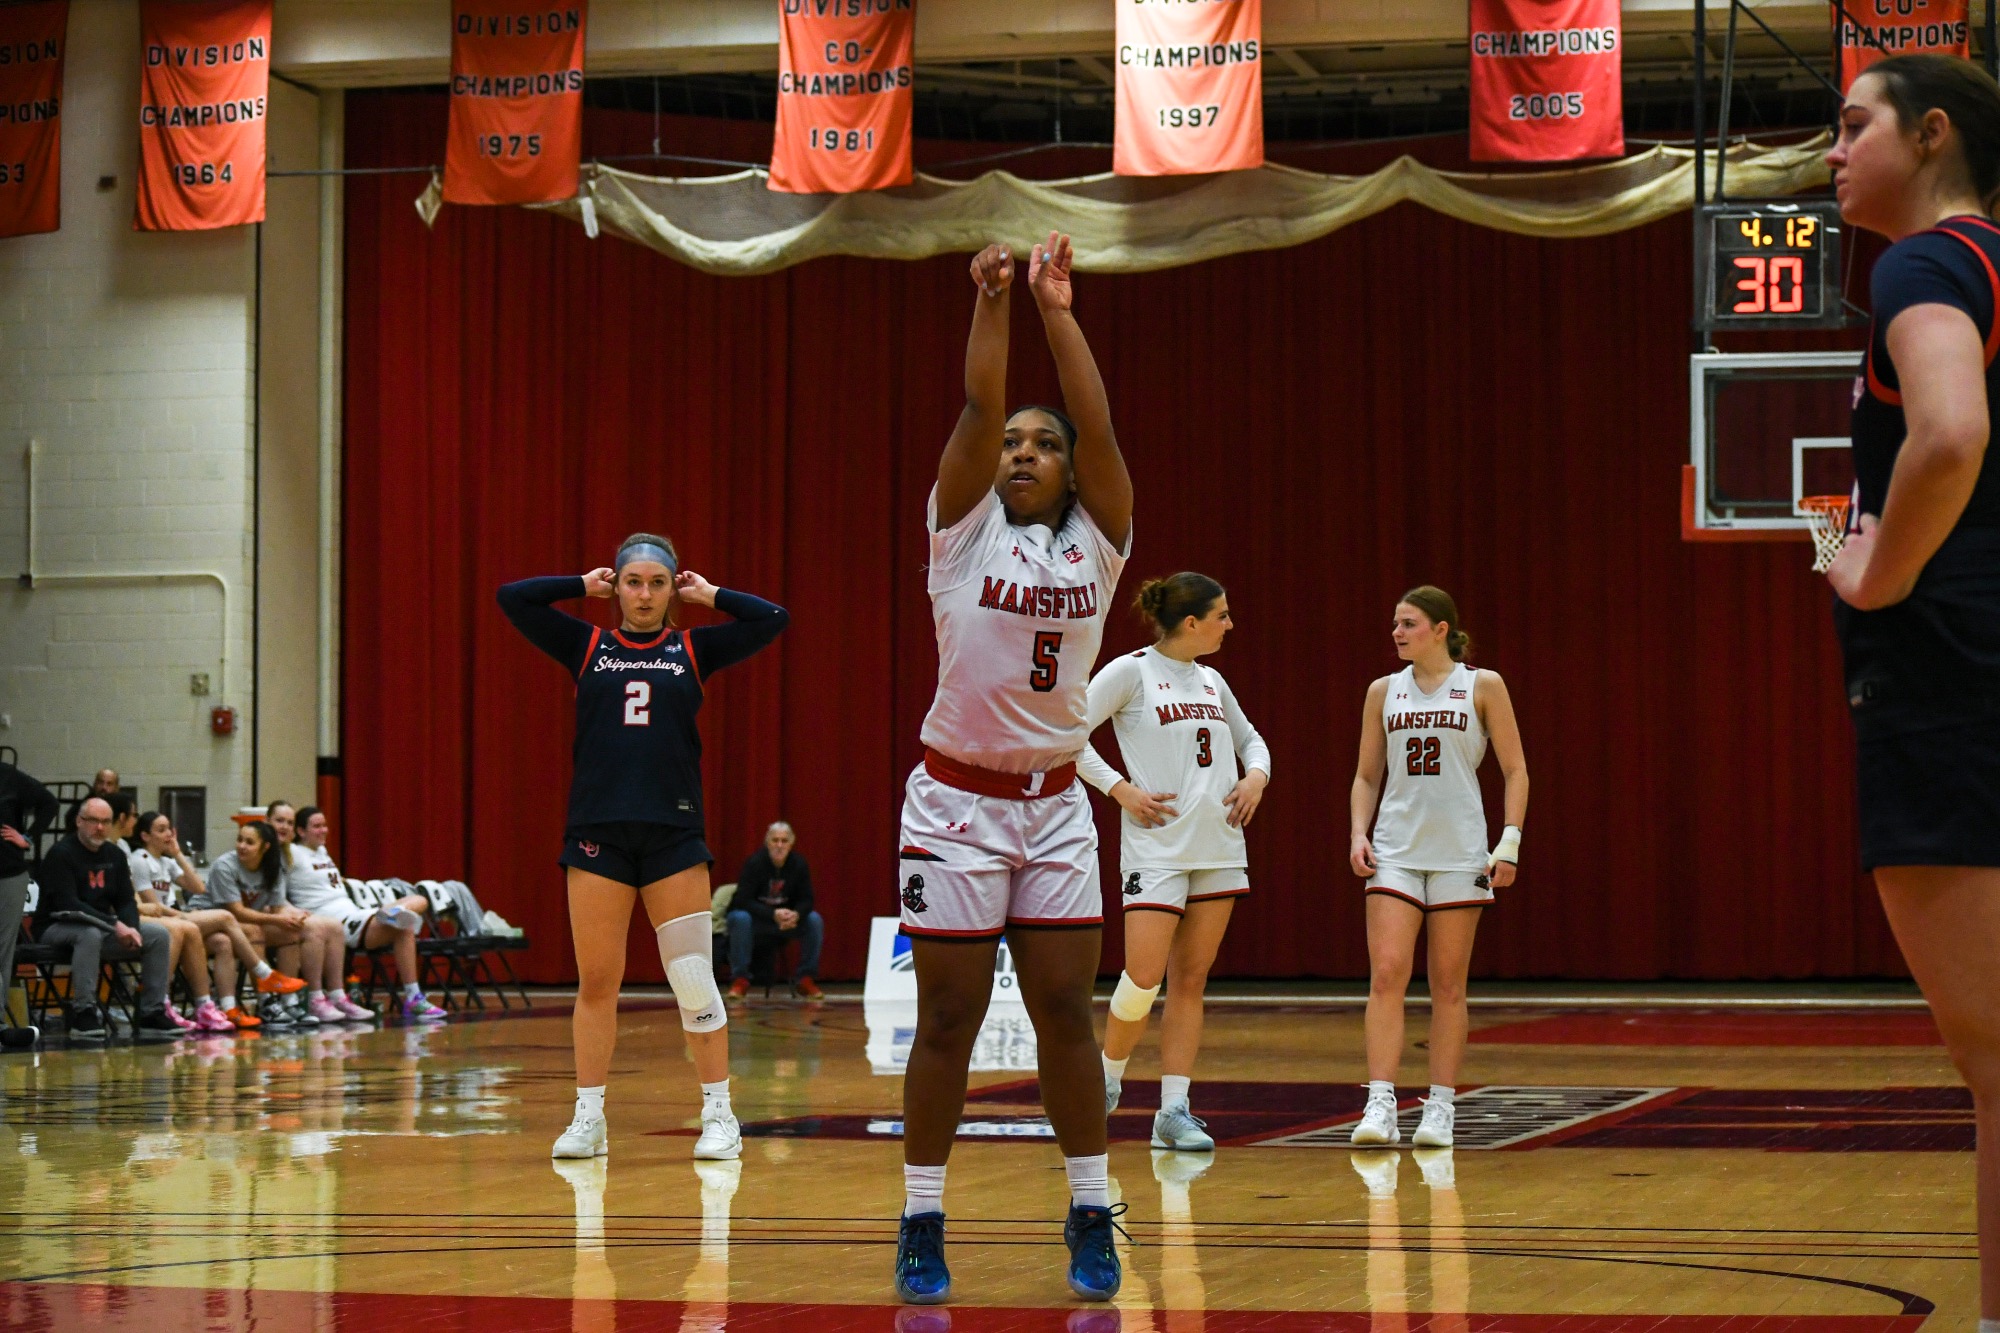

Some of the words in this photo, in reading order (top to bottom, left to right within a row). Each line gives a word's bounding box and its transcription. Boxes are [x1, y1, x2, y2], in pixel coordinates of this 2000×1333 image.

[457, 10, 580, 36] DIVISION
[1844, 22, 1968, 48] HAMPIONS
[147, 37, 264, 67] DIVISION
[825, 41, 873, 63] CO-
[1119, 41, 1258, 67] CHAMPIONS
[1474, 29, 1615, 55] CHAMPIONS
[452, 70, 584, 97] CHAMPIONS
[781, 66, 911, 95] CHAMPIONS
[141, 97, 264, 128] CHAMPIONS
[1160, 106, 1219, 128] 1997
[1511, 94, 1583, 118] 2005
[479, 135, 541, 157] 1975
[811, 129, 873, 151] 1981
[174, 163, 232, 185] 1964
[1733, 257, 1803, 313] 30
[593, 655, 685, 676] Shippensburg
[1030, 631, 1063, 692] 5
[624, 680, 651, 726] 2
[1155, 702, 1228, 726] MANSFIEL
[1196, 727, 1213, 768] 3
[1406, 736, 1441, 776] 22
